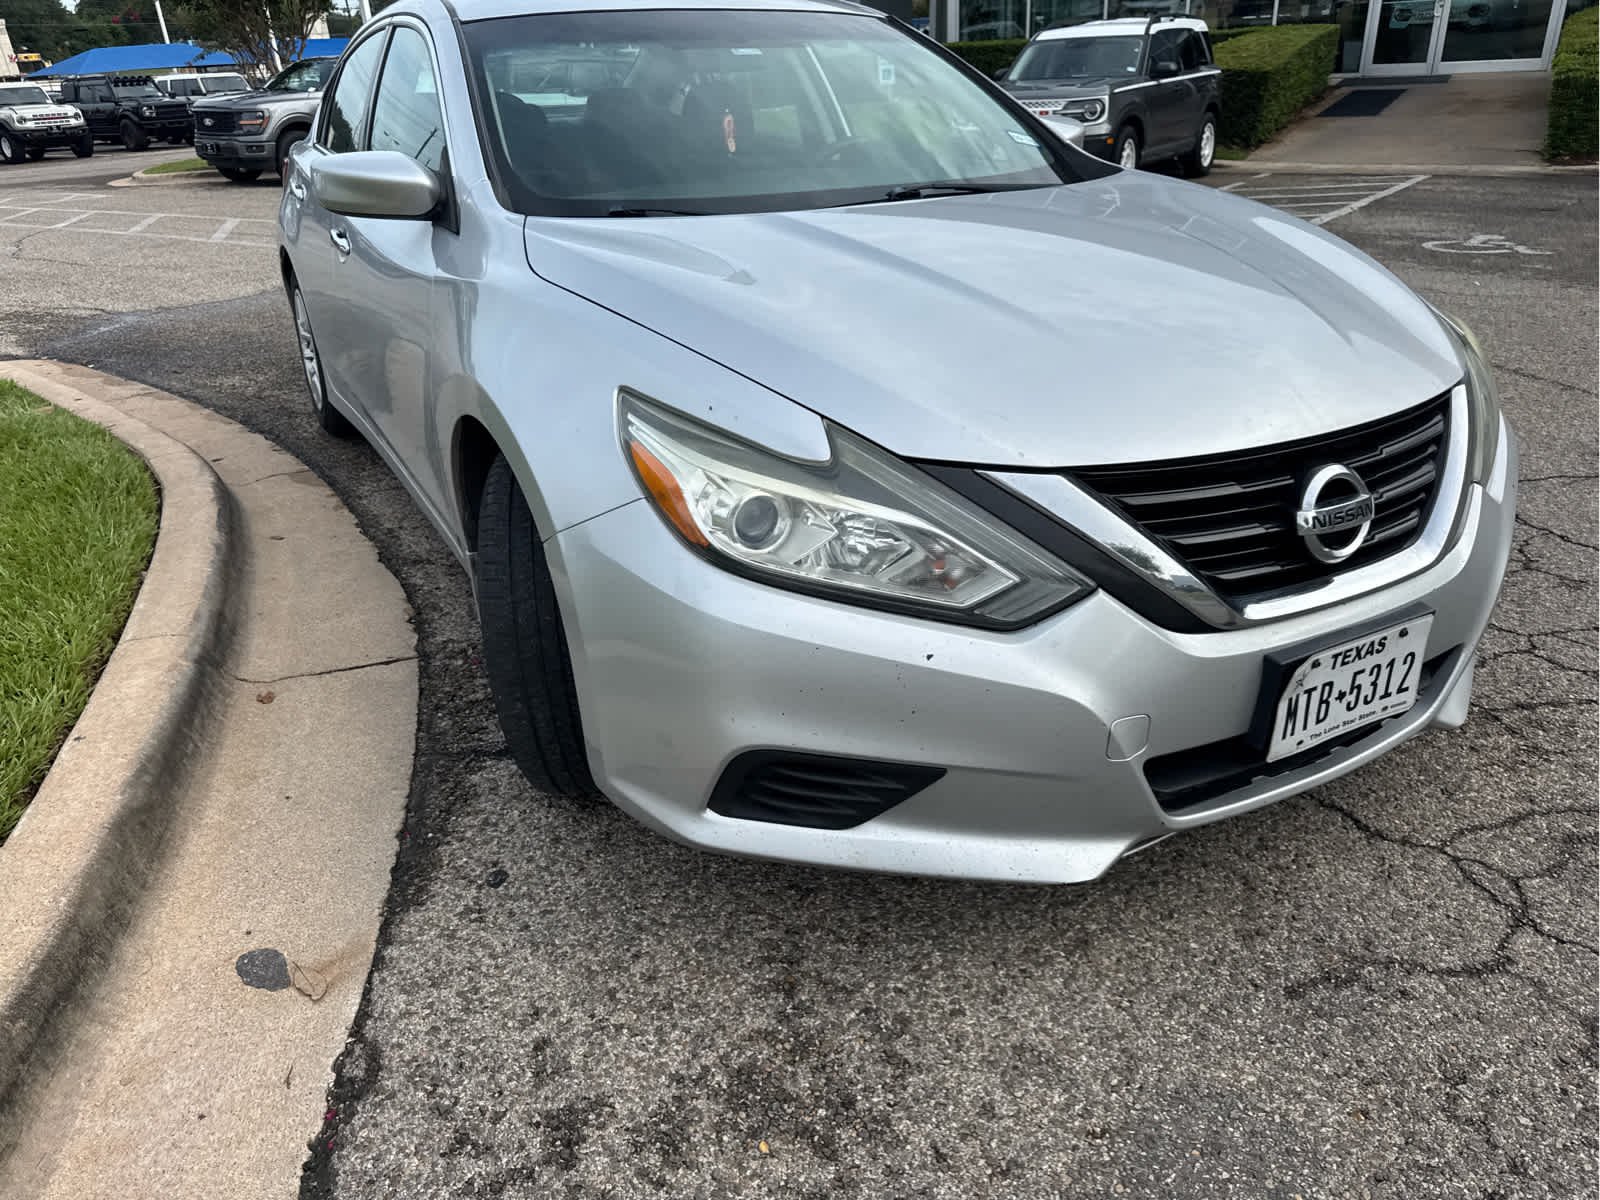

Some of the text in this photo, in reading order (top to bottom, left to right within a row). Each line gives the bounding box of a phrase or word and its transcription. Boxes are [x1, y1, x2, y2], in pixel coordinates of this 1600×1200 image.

[1312, 503, 1371, 530] NISSAN
[1331, 636, 1387, 670] TEXAS
[1310, 730, 1323, 740] The
[1324, 724, 1340, 735] Lone
[1342, 717, 1357, 727] Star
